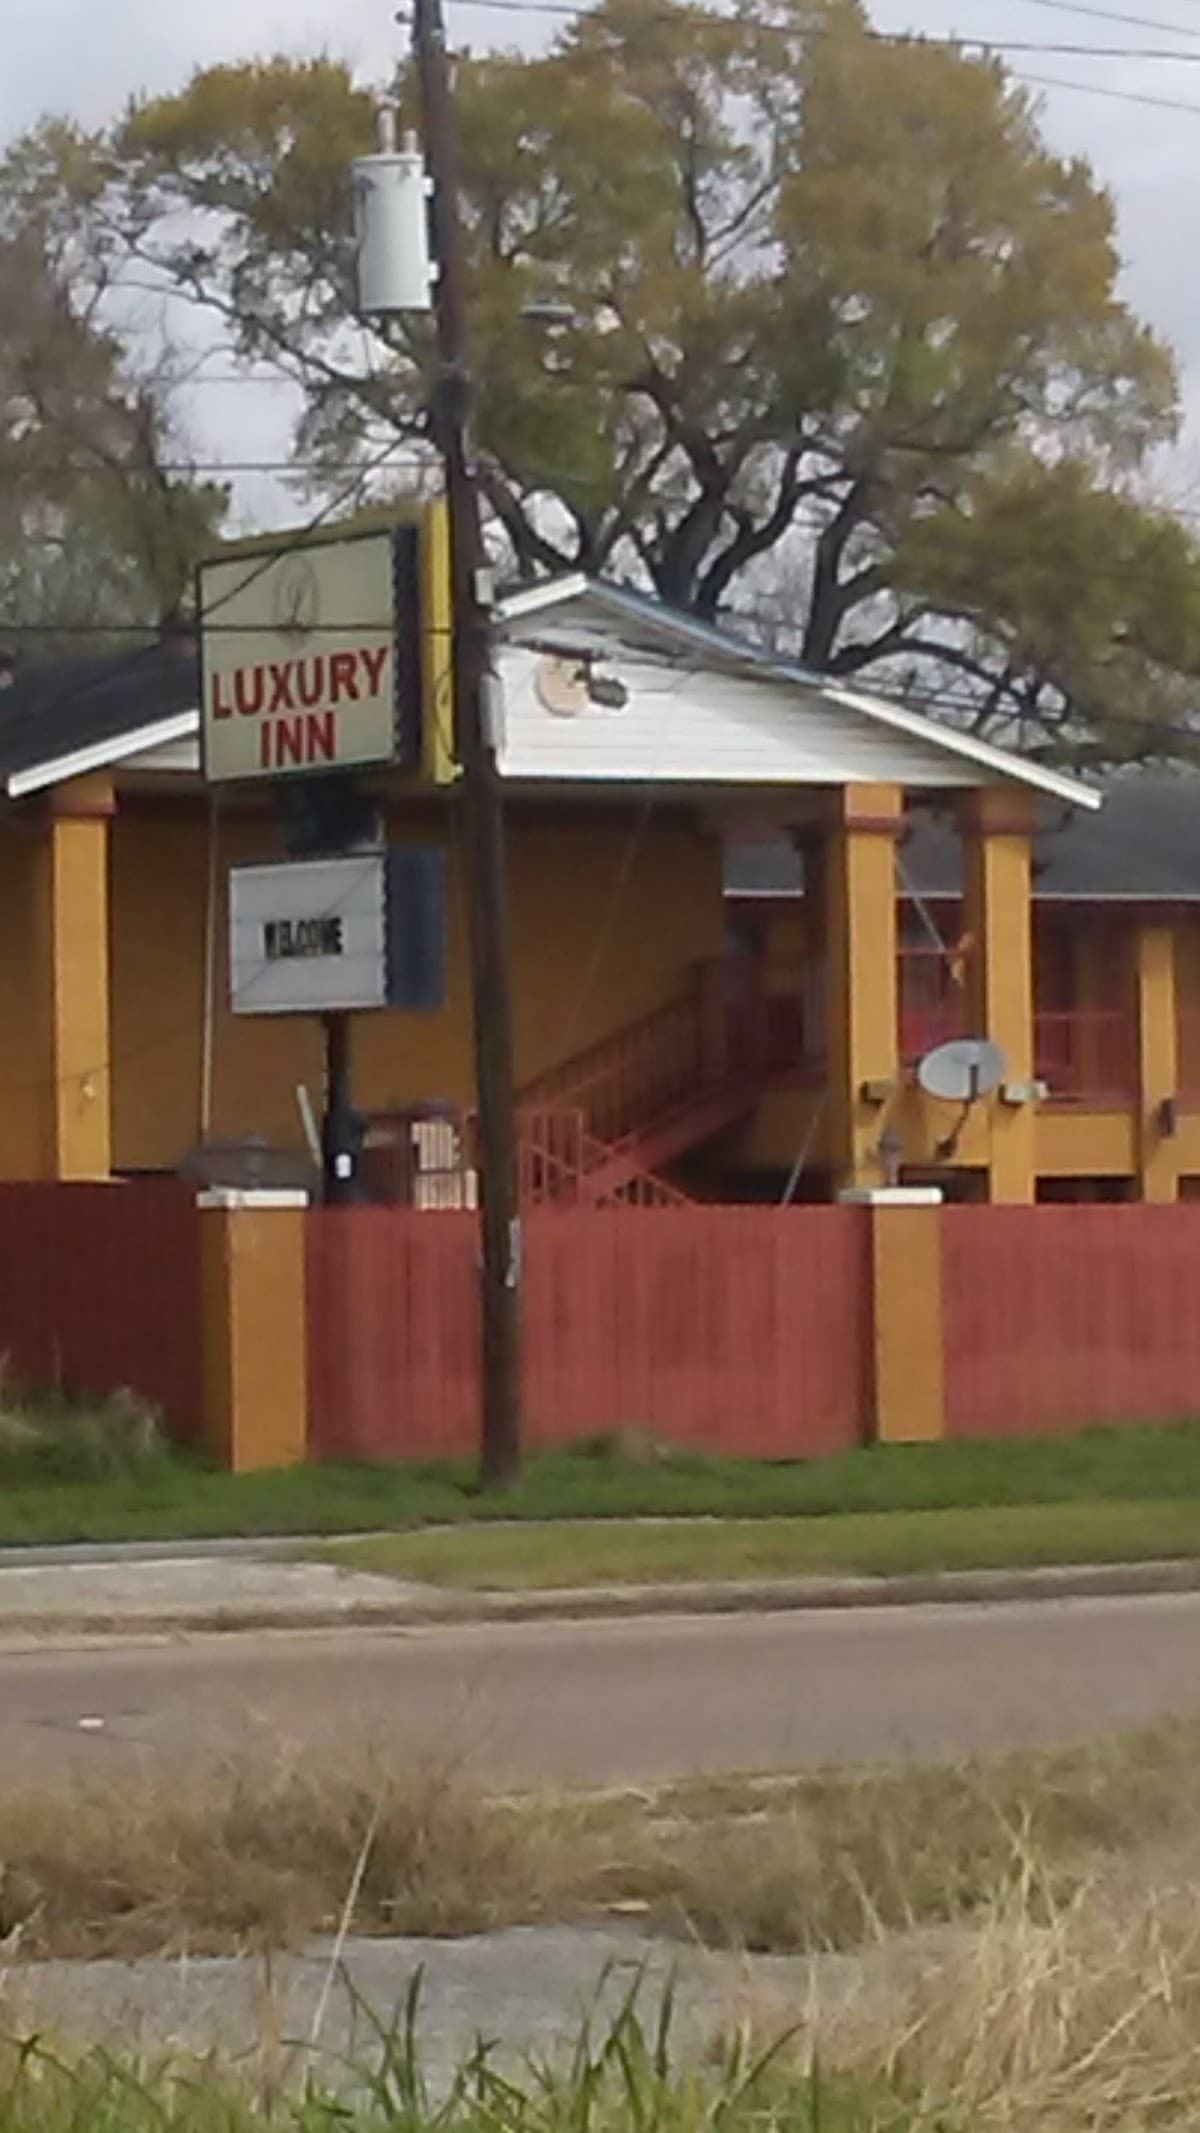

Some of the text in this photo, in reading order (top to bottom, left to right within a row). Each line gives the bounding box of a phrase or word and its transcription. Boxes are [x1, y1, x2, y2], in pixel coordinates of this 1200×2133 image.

[212, 647, 389, 720] LUXURY
[261, 711, 336, 768] INN
[264, 917, 343, 959] WELCOME
